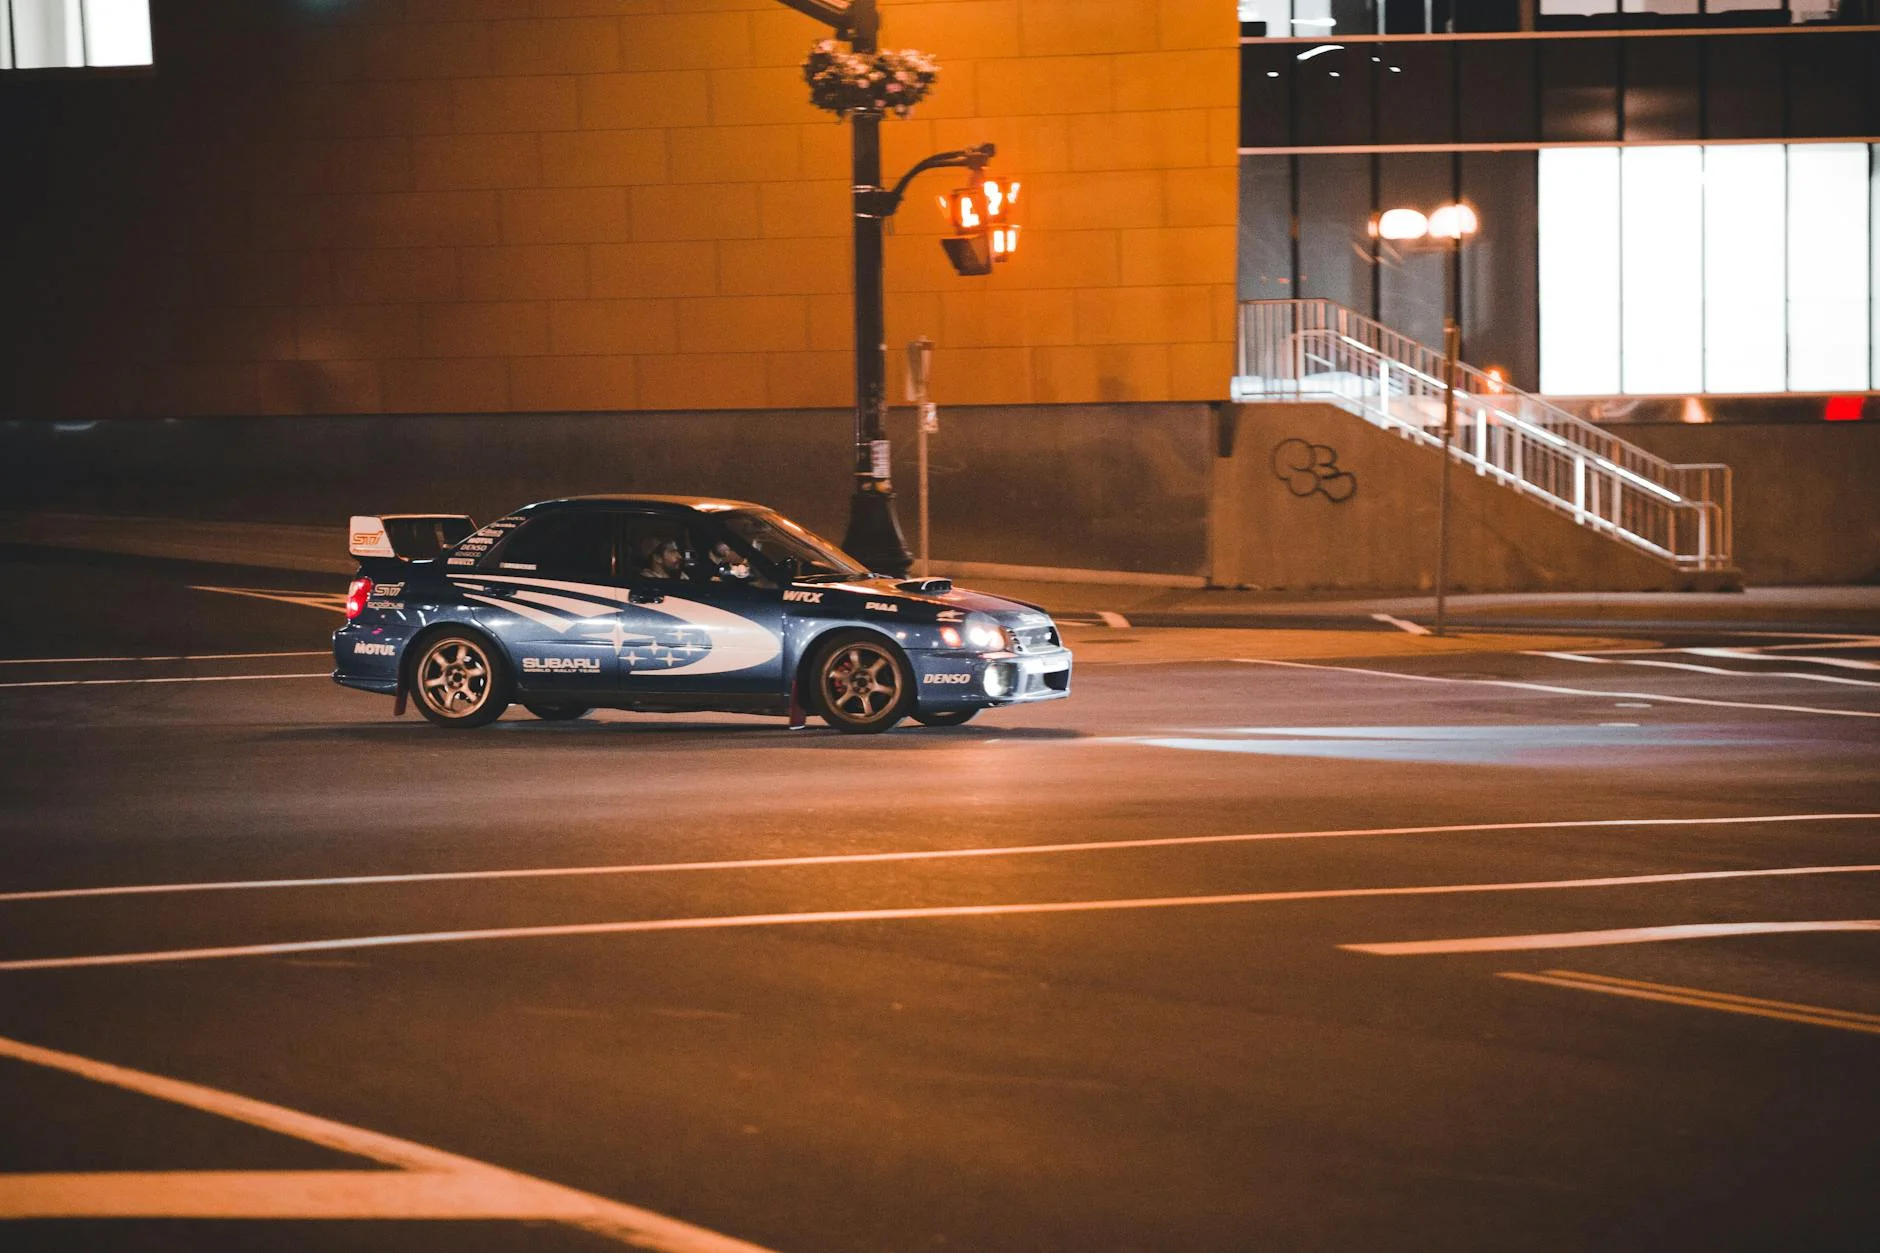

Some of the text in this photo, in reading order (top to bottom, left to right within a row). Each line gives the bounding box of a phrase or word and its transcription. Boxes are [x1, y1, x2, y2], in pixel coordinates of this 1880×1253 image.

[460, 544, 488, 552] DENSO
[783, 590, 823, 603] WRX
[865, 602, 898, 612] PIAA
[354, 643, 395, 655] MOTUL
[522, 657, 600, 669] SUBARU
[923, 673, 971, 684] DENSO
